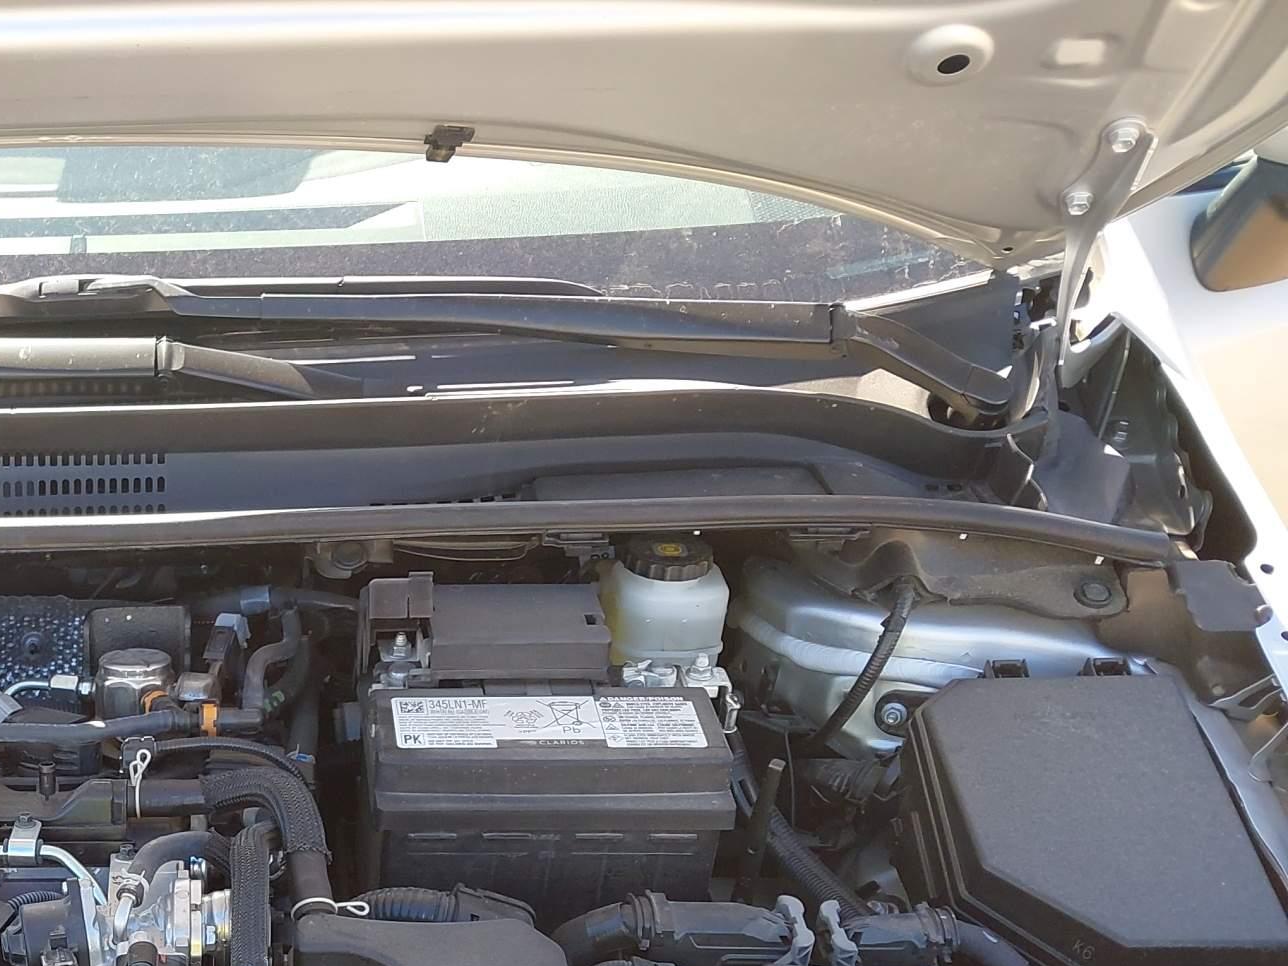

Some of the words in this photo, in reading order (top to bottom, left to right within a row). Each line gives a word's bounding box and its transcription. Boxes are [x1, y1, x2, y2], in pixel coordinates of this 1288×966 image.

[428, 699, 487, 709] 345LN1-MF
[562, 726, 581, 734] Pb
[403, 734, 422, 744] PK
